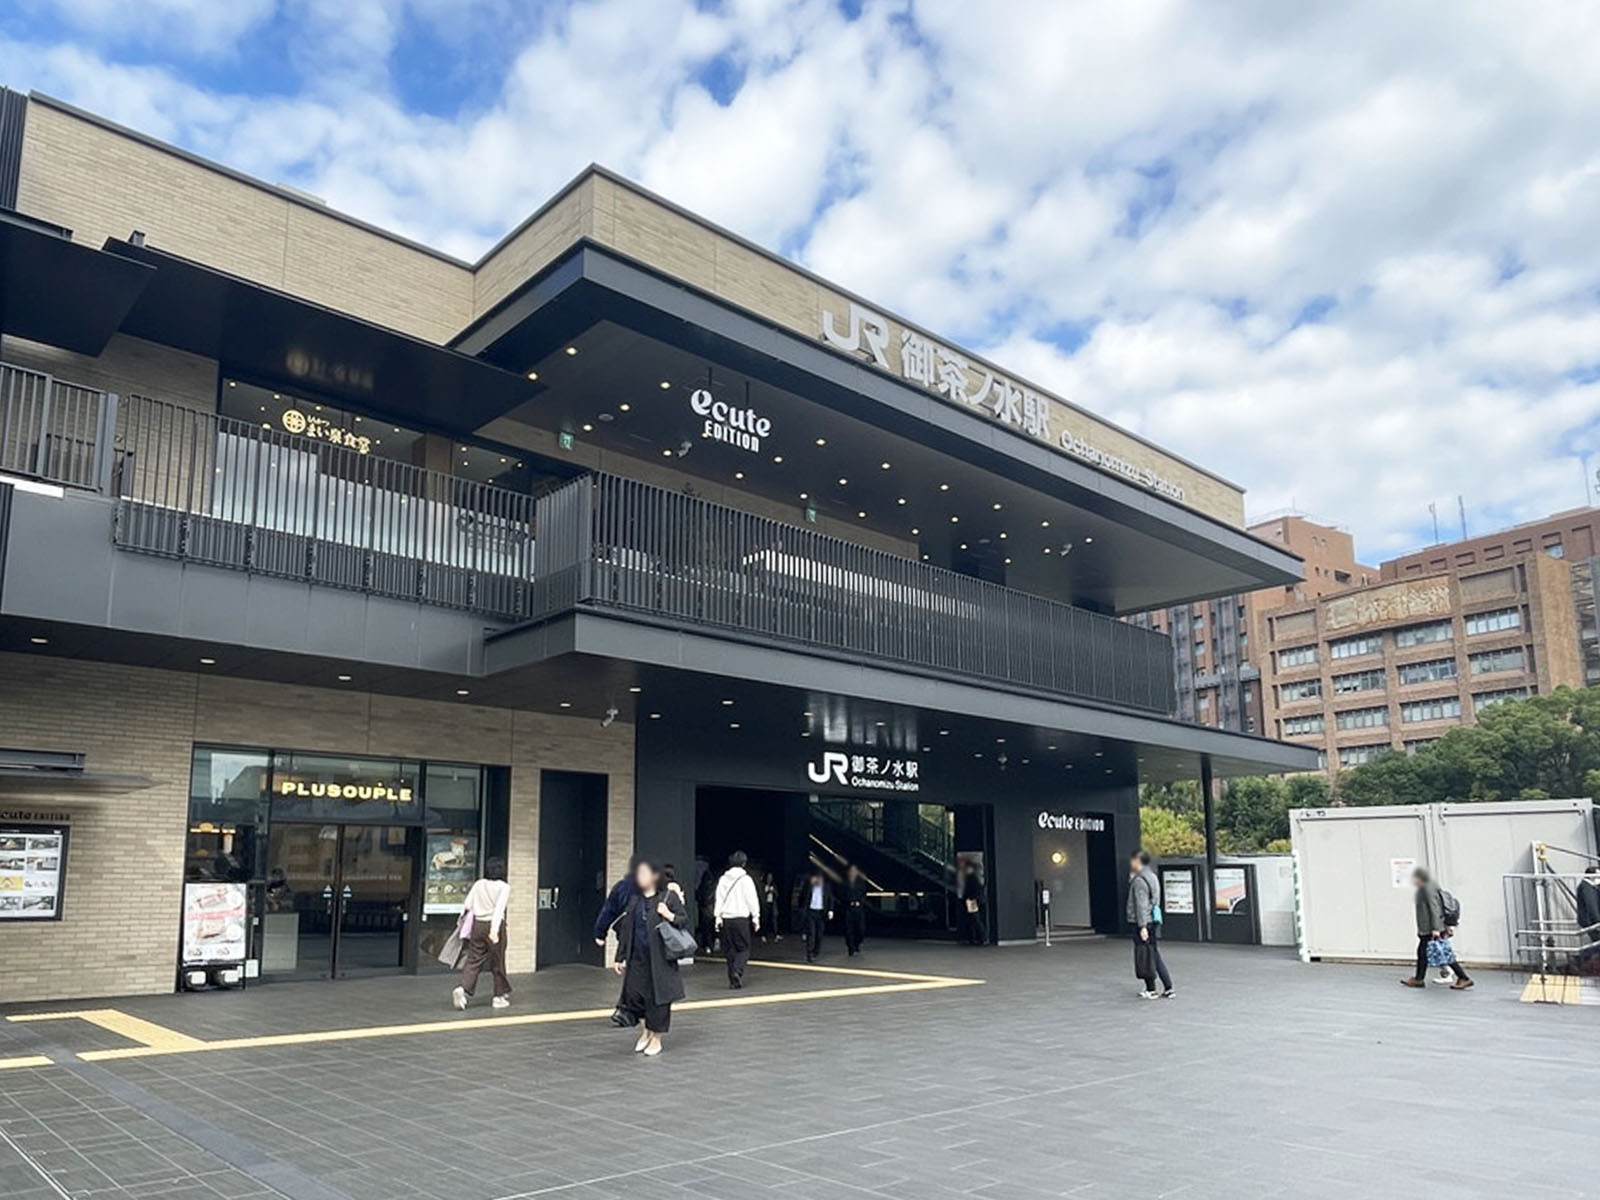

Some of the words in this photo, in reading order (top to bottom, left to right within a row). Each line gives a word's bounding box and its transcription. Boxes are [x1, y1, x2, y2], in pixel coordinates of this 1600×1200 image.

[822, 304, 890, 369] JR
[900, 328, 1051, 440] 御茶ノ水駅
[690, 388, 771, 438] ecute
[306, 423, 371, 455] まい泉食堂
[703, 419, 760, 453] EDITION
[1059, 429, 1141, 482] Ochanomizu
[1143, 467, 1185, 501] Station
[808, 751, 849, 785] JR
[851, 754, 919, 779] 御茶ノ水駅
[851, 776, 894, 789] Ochanomizu
[895, 779, 919, 791] Station
[281, 781, 413, 802] PLUSOUPLE
[1038, 811, 1074, 831] ecute
